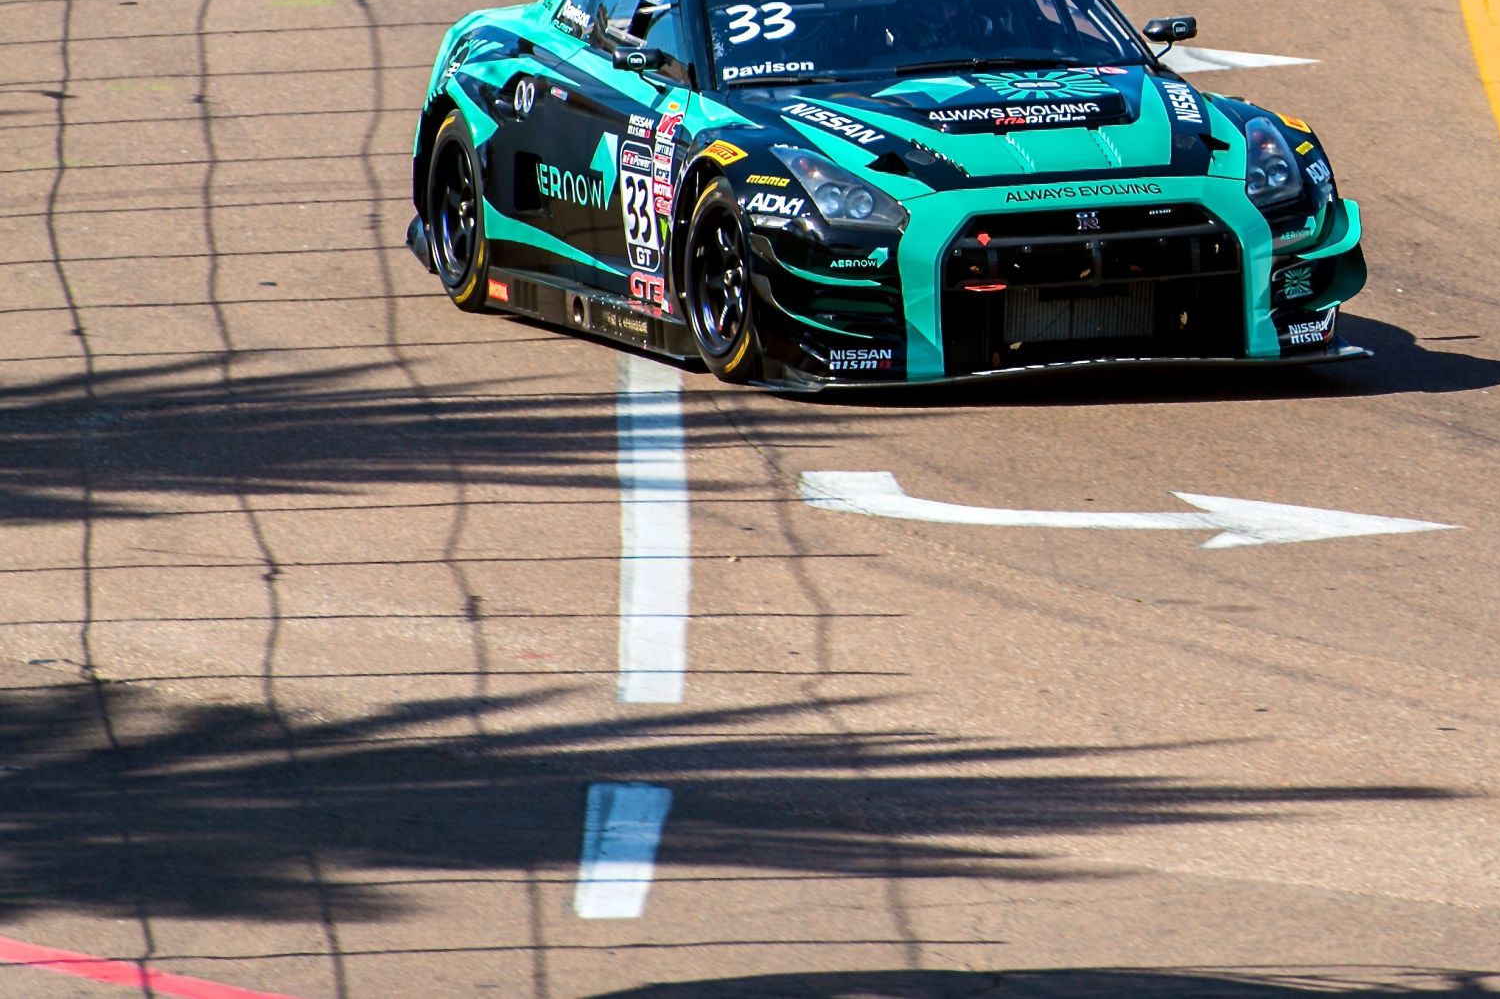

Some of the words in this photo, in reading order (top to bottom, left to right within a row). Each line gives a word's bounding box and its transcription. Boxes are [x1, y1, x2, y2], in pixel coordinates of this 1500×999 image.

[725, 2, 796, 45] 33
[722, 61, 815, 81] Davison
[928, 107, 1006, 122] ALWAYS
[1005, 102, 1101, 117] EVOLVING
[1162, 80, 1203, 124] NISSAN
[629, 113, 656, 131] NISSAN
[780, 102, 885, 145] NISSAN
[746, 174, 791, 188] momo
[1006, 186, 1077, 203] ALWAYS
[1078, 183, 1162, 197] EVOLVING
[625, 175, 652, 243] 33
[636, 246, 652, 266] GT
[629, 271, 665, 304] GT3
[1287, 320, 1328, 335] NISSAN
[829, 348, 893, 361] NISSAN
